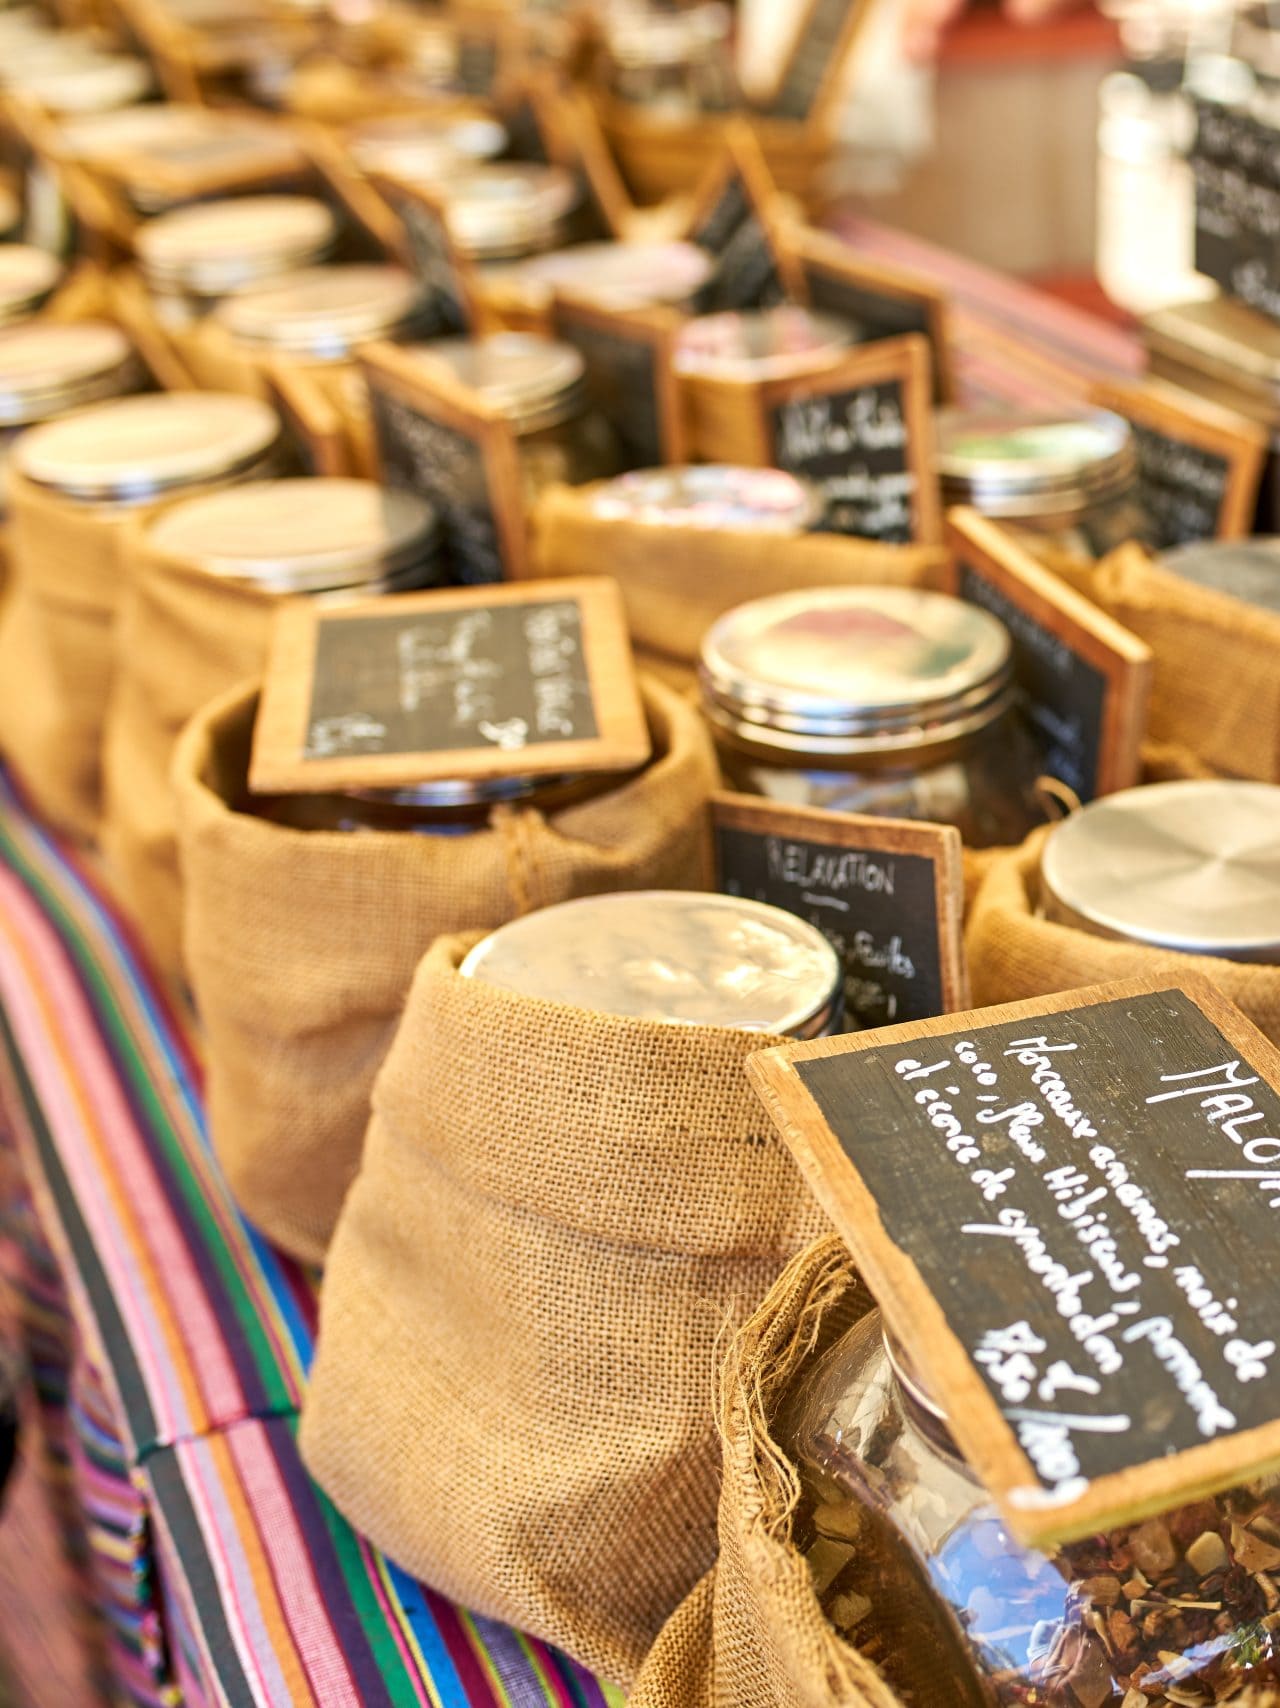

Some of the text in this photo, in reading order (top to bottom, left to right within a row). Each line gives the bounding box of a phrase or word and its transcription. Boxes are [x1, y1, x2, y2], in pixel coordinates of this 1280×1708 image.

[894, 1058, 951, 1081] et
[970, 1167, 1017, 1201] de
[1003, 1035, 1098, 1139] Morceaux
[1088, 1145, 1181, 1268] ananas,
[1223, 1338, 1277, 1383] de
